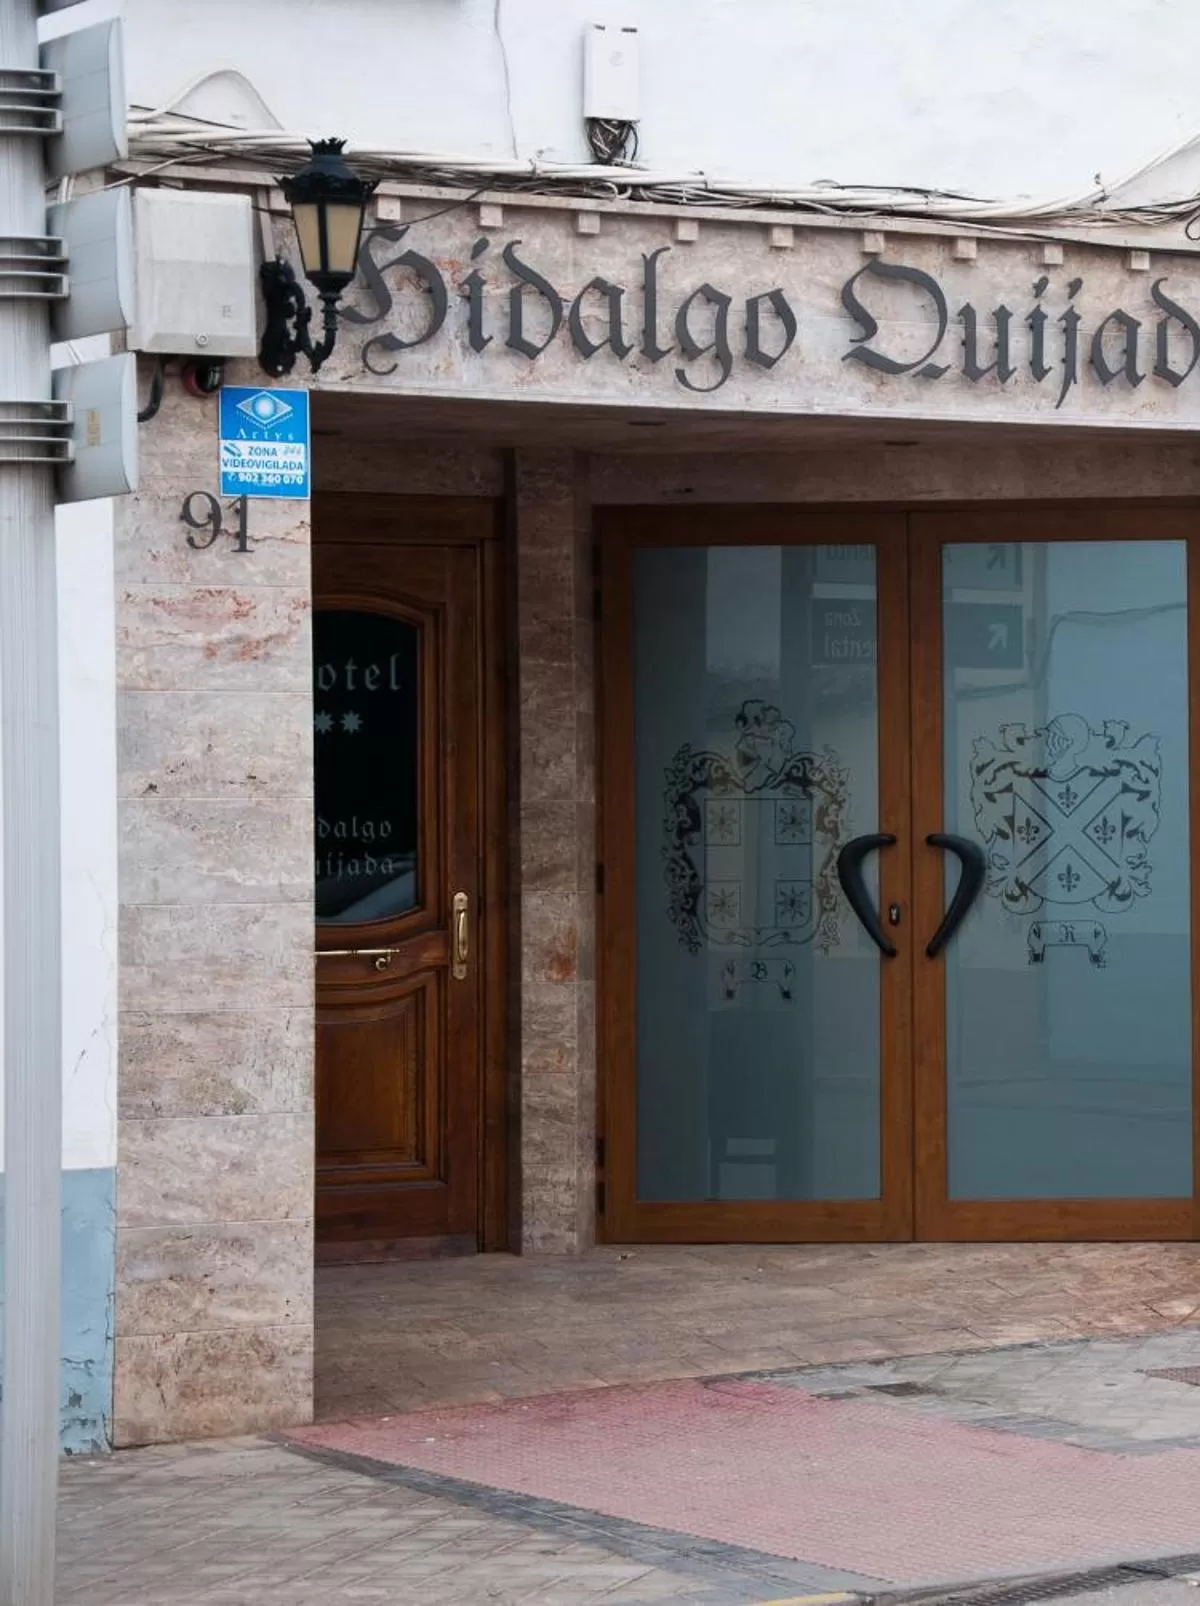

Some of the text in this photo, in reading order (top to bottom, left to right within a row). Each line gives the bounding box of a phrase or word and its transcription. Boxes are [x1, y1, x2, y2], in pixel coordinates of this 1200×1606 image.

[340, 226, 798, 392] Hidalgo
[236, 427, 295, 441] Artys
[222, 457, 304, 471] VIDEOVIGILADA
[248, 446, 278, 457] ZONA
[182, 490, 255, 553] 91
[317, 652, 402, 692] otel
[317, 815, 393, 843] dalgo
[315, 852, 394, 882] ijada
